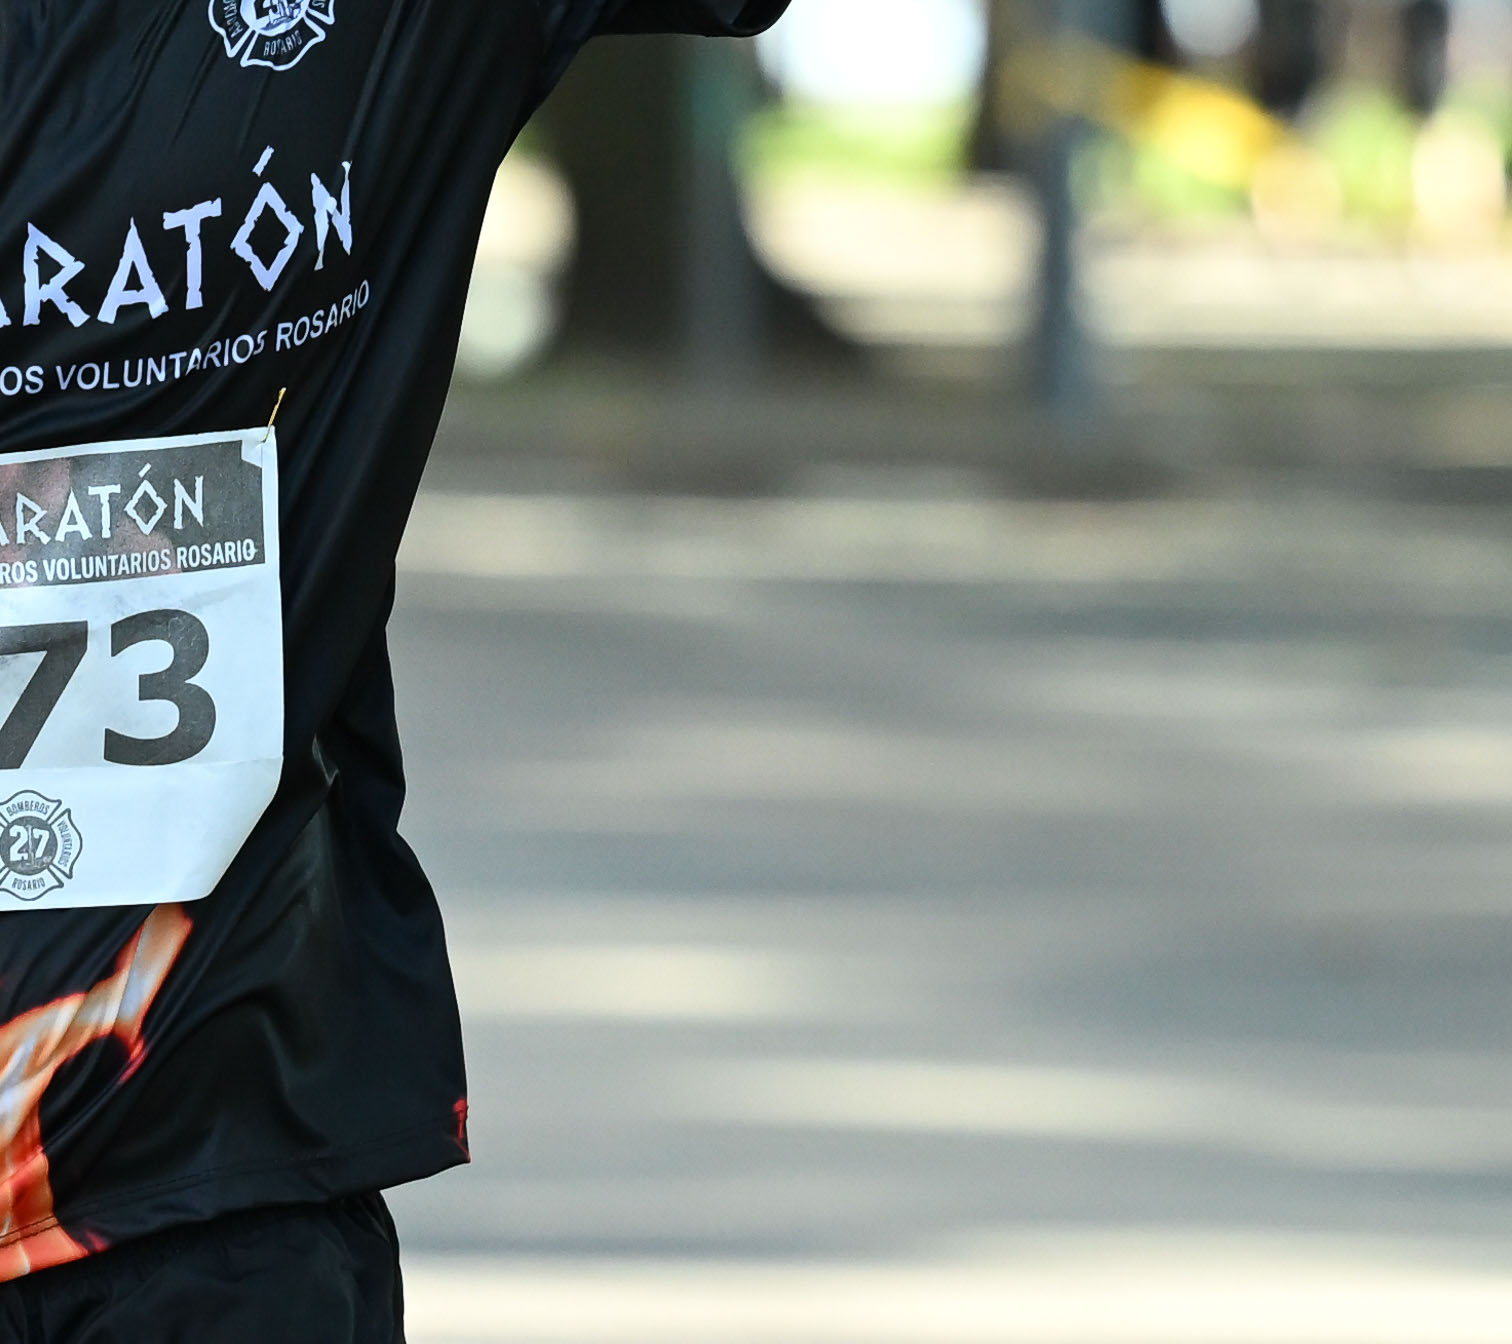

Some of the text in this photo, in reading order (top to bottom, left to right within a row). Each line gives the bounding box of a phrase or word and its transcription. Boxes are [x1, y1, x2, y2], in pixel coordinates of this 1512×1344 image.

[56, 328, 270, 392] VOLUNTARIOS
[276, 280, 371, 352] ROSARIO
[46, 549, 171, 582] VOLUNTARIOS
[177, 538, 256, 567] ROSARIO
[6, 800, 50, 816] BOMBEROS
[9, 824, 50, 862] 27
[12, 877, 46, 891] ROSARIO
